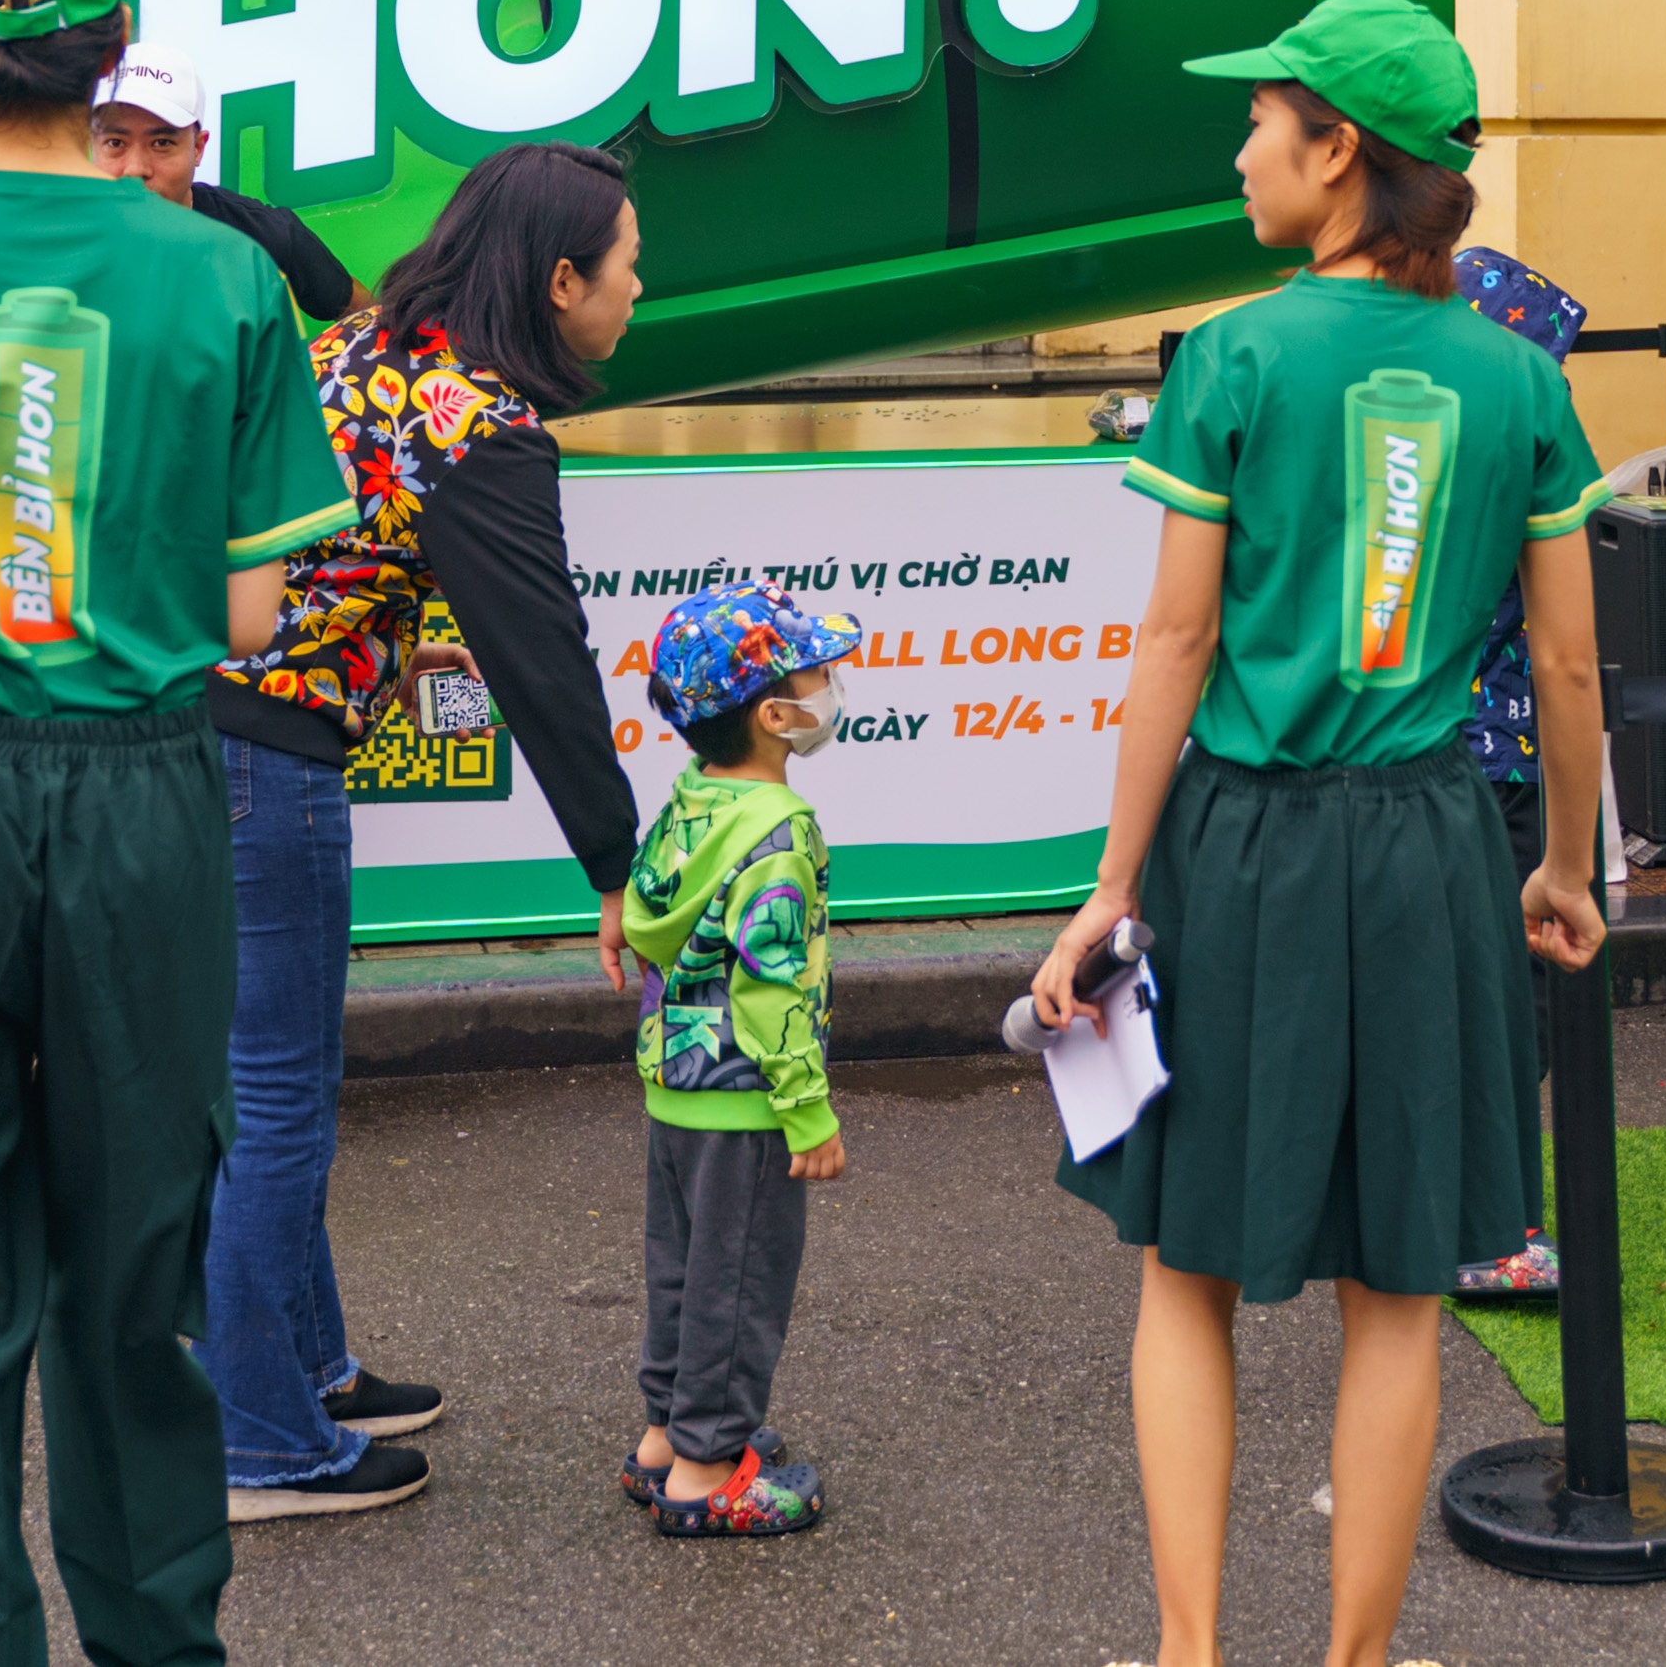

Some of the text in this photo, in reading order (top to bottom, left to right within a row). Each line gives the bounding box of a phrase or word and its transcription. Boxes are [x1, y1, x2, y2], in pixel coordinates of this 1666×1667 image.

[0, 360, 59, 624] BỀN BỈ HƠN
[1384, 433, 1420, 529] HƠN
[569, 563, 621, 598] ÒN
[762, 556, 839, 592] THÚ
[850, 561, 888, 597] VỊ
[897, 552, 982, 588] CHỜ
[988, 557, 1071, 592] BẠN
[939, 624, 1085, 666] LONG
[952, 694, 1046, 741] 12/4
